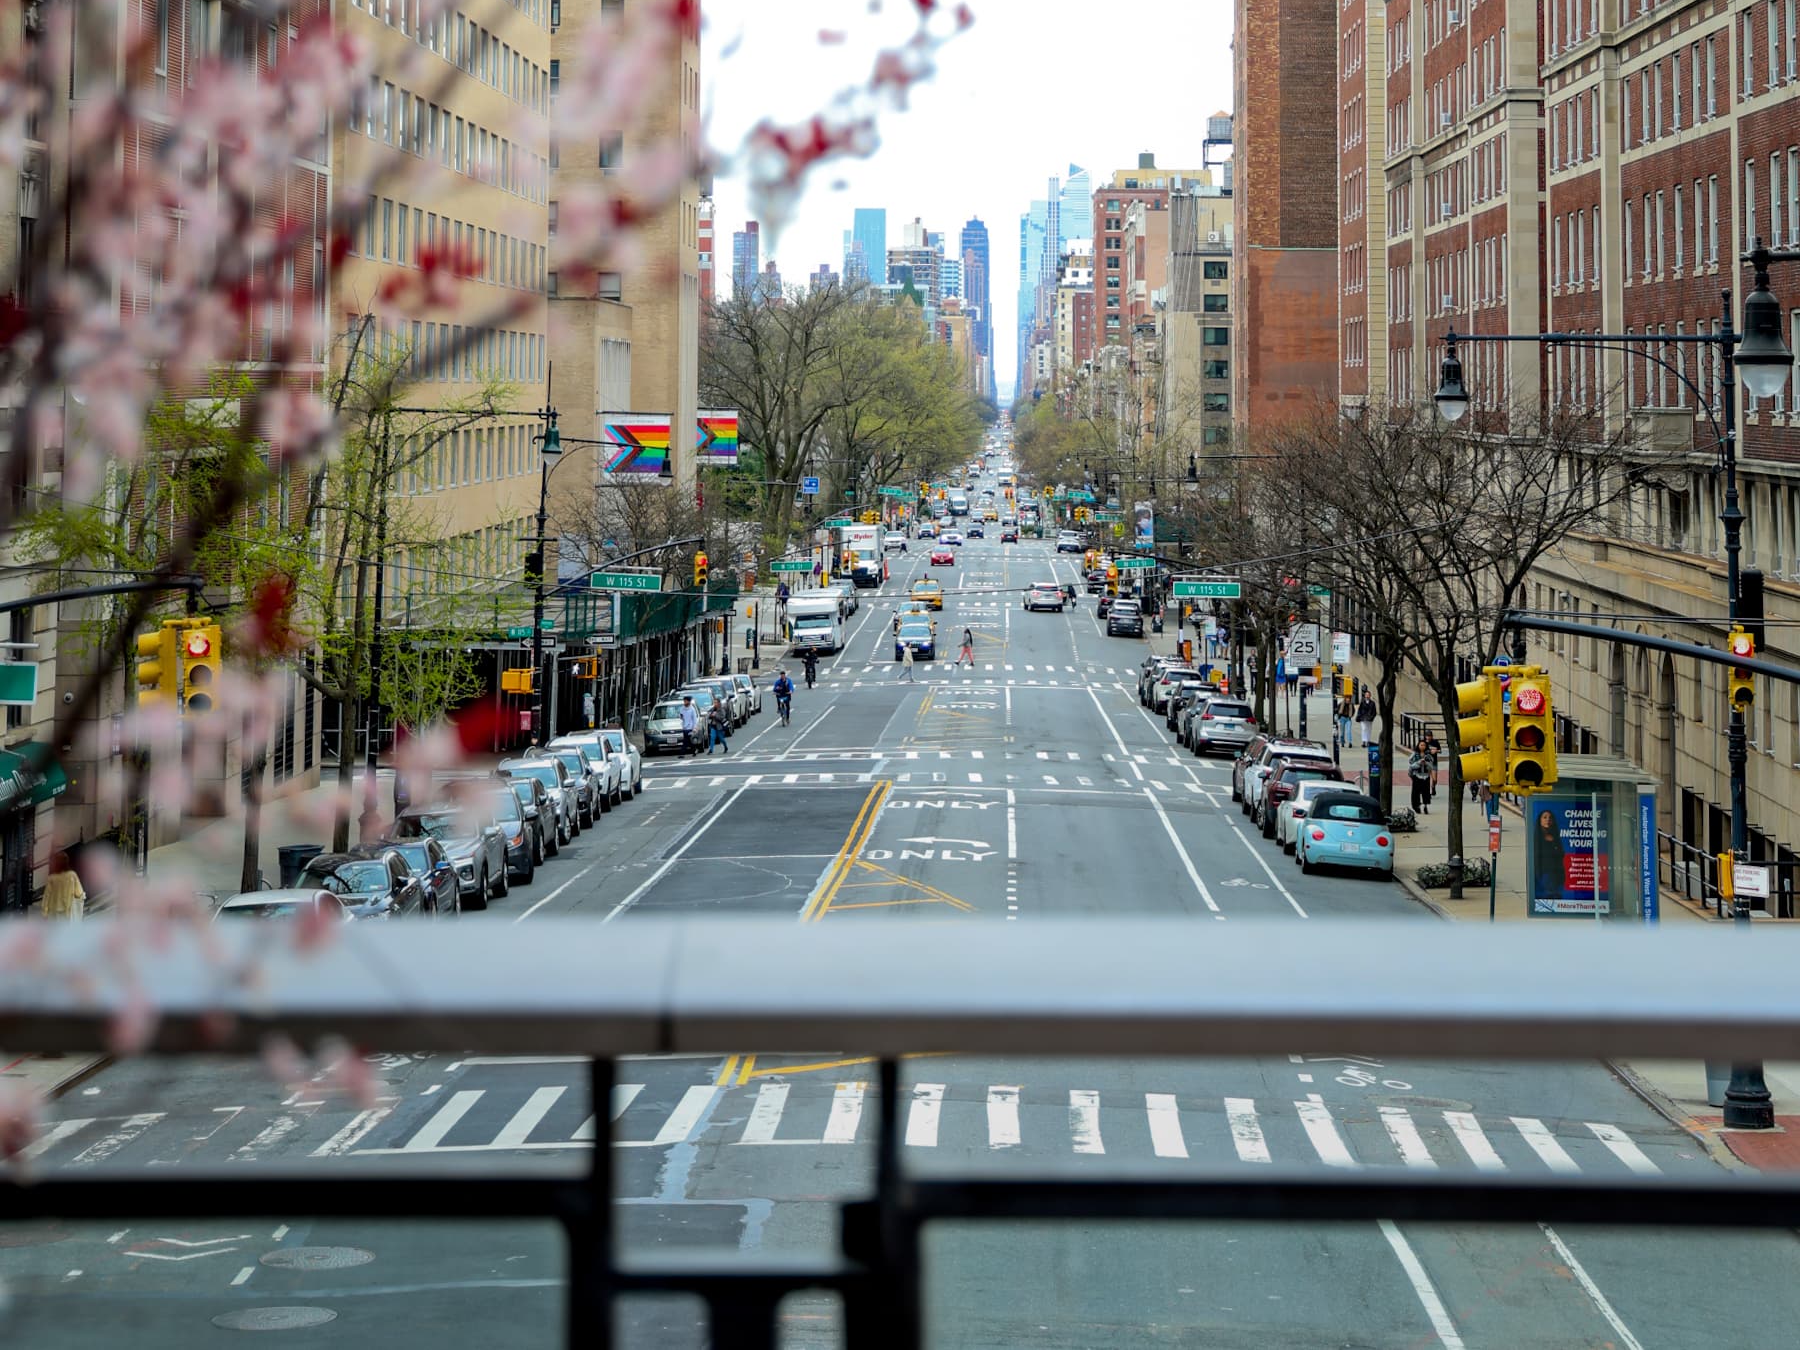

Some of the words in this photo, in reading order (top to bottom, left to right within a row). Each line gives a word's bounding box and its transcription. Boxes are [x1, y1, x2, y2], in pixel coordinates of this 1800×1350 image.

[606, 576, 615, 586] W
[619, 577, 633, 587] 115
[637, 577, 646, 587] St
[1188, 586, 1196, 595] W
[1200, 586, 1213, 595] 115
[1217, 586, 1226, 595] St
[1294, 641, 1314, 653] 25
[886, 800, 1000, 810] ONLY
[1560, 829, 1607, 838] INCLUDNG
[1569, 839, 1597, 848] YOUR
[866, 849, 1000, 862] ONLY
